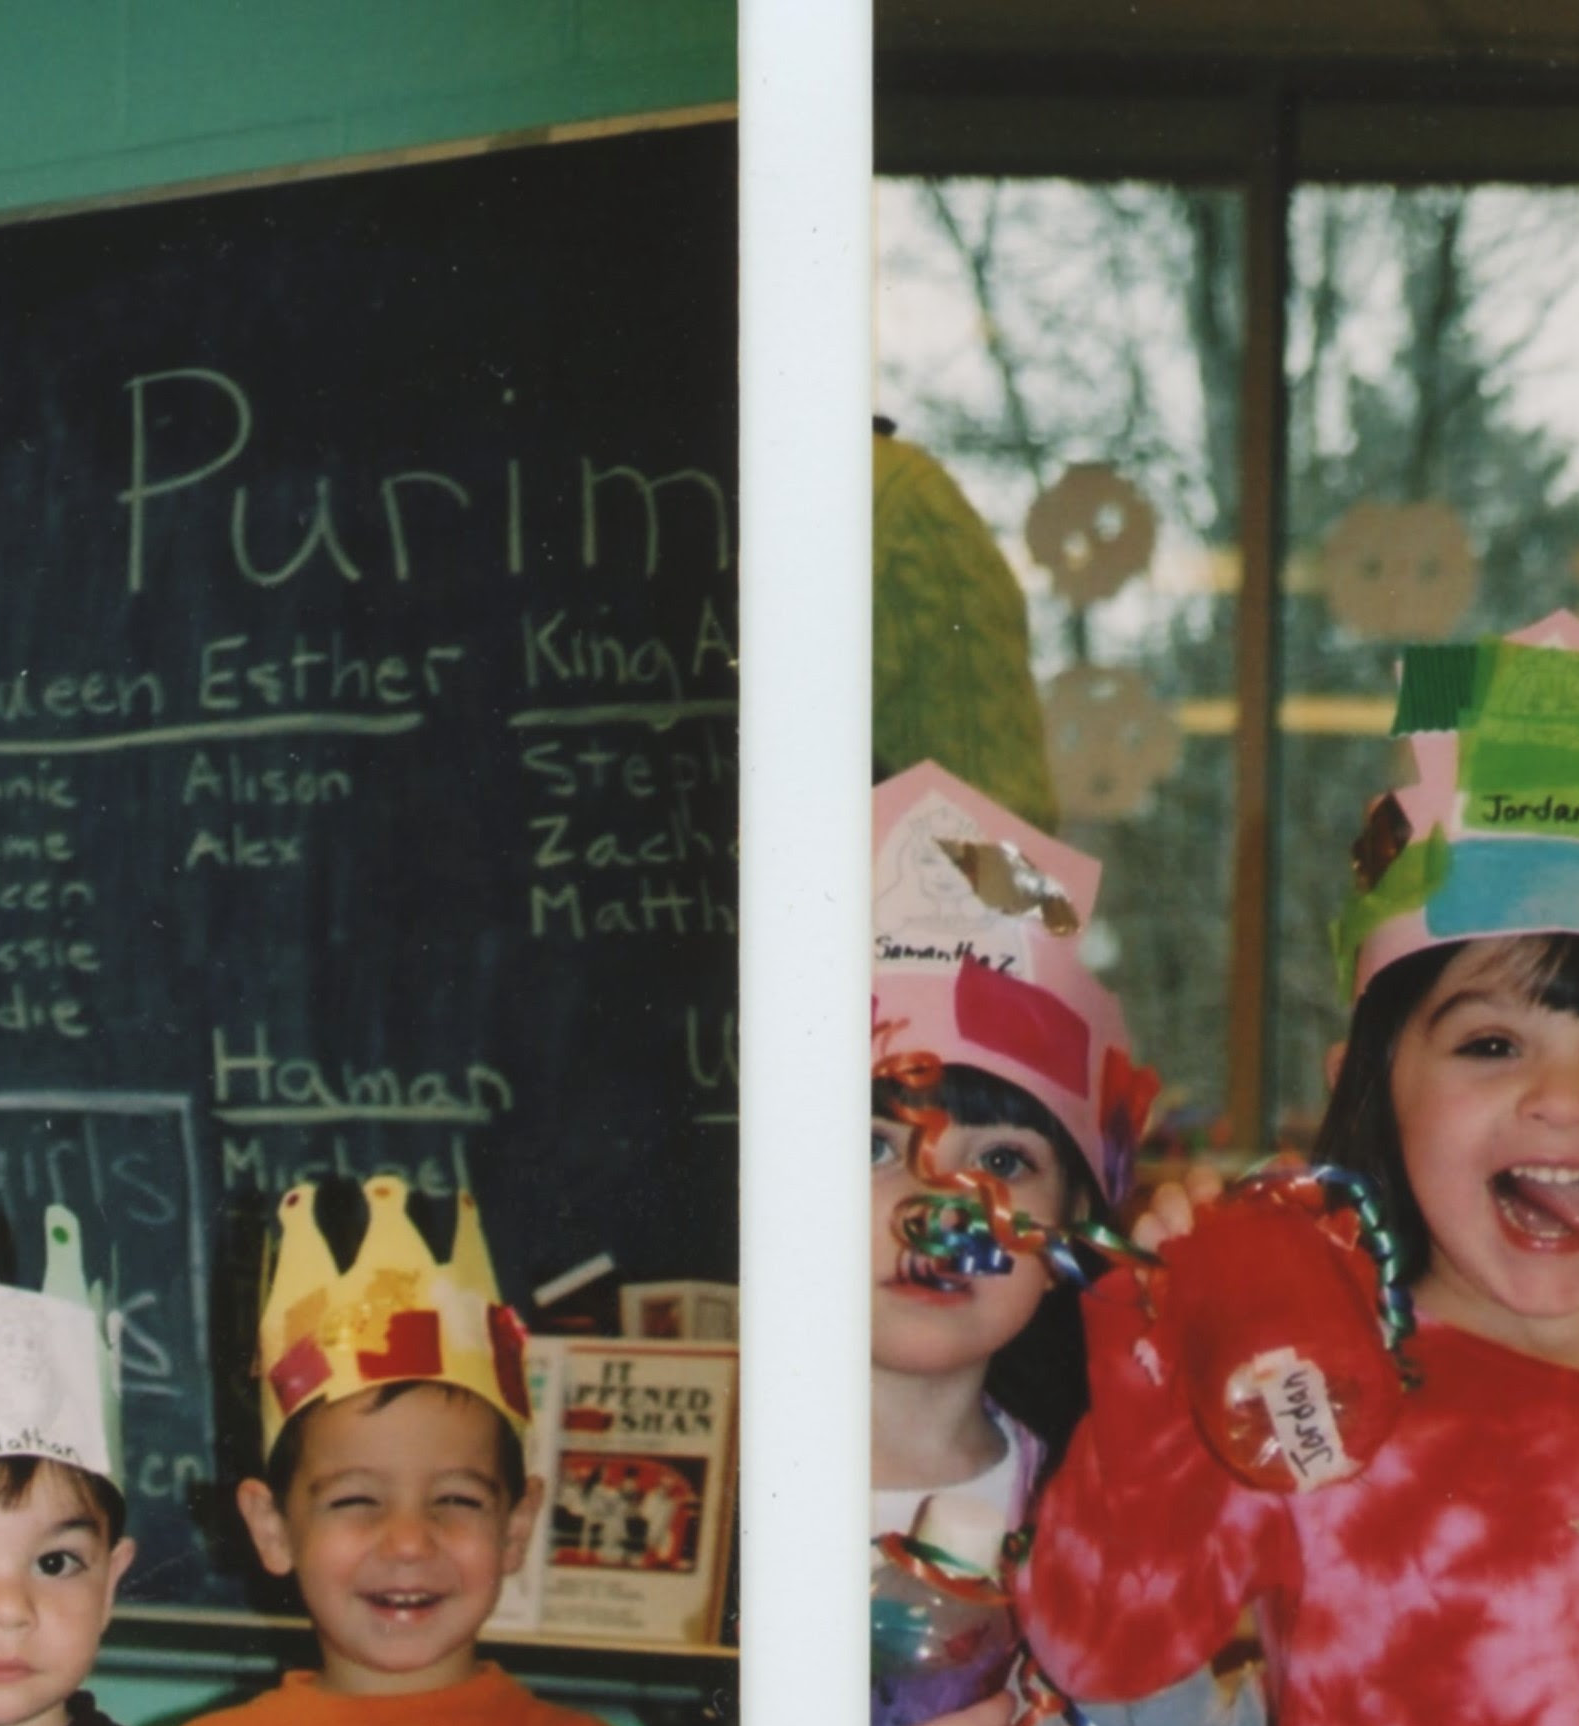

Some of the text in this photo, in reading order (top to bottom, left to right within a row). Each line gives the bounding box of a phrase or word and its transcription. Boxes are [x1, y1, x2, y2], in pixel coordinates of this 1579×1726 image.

[119, 366, 734, 592] Purim
[198, 632, 465, 710] Esther
[520, 606, 684, 712] King
[183, 752, 352, 806] Alison
[186, 822, 302, 869] Alex
[213, 1020, 513, 1110] Haman
[1277, 1369, 1334, 1478] Jordan
